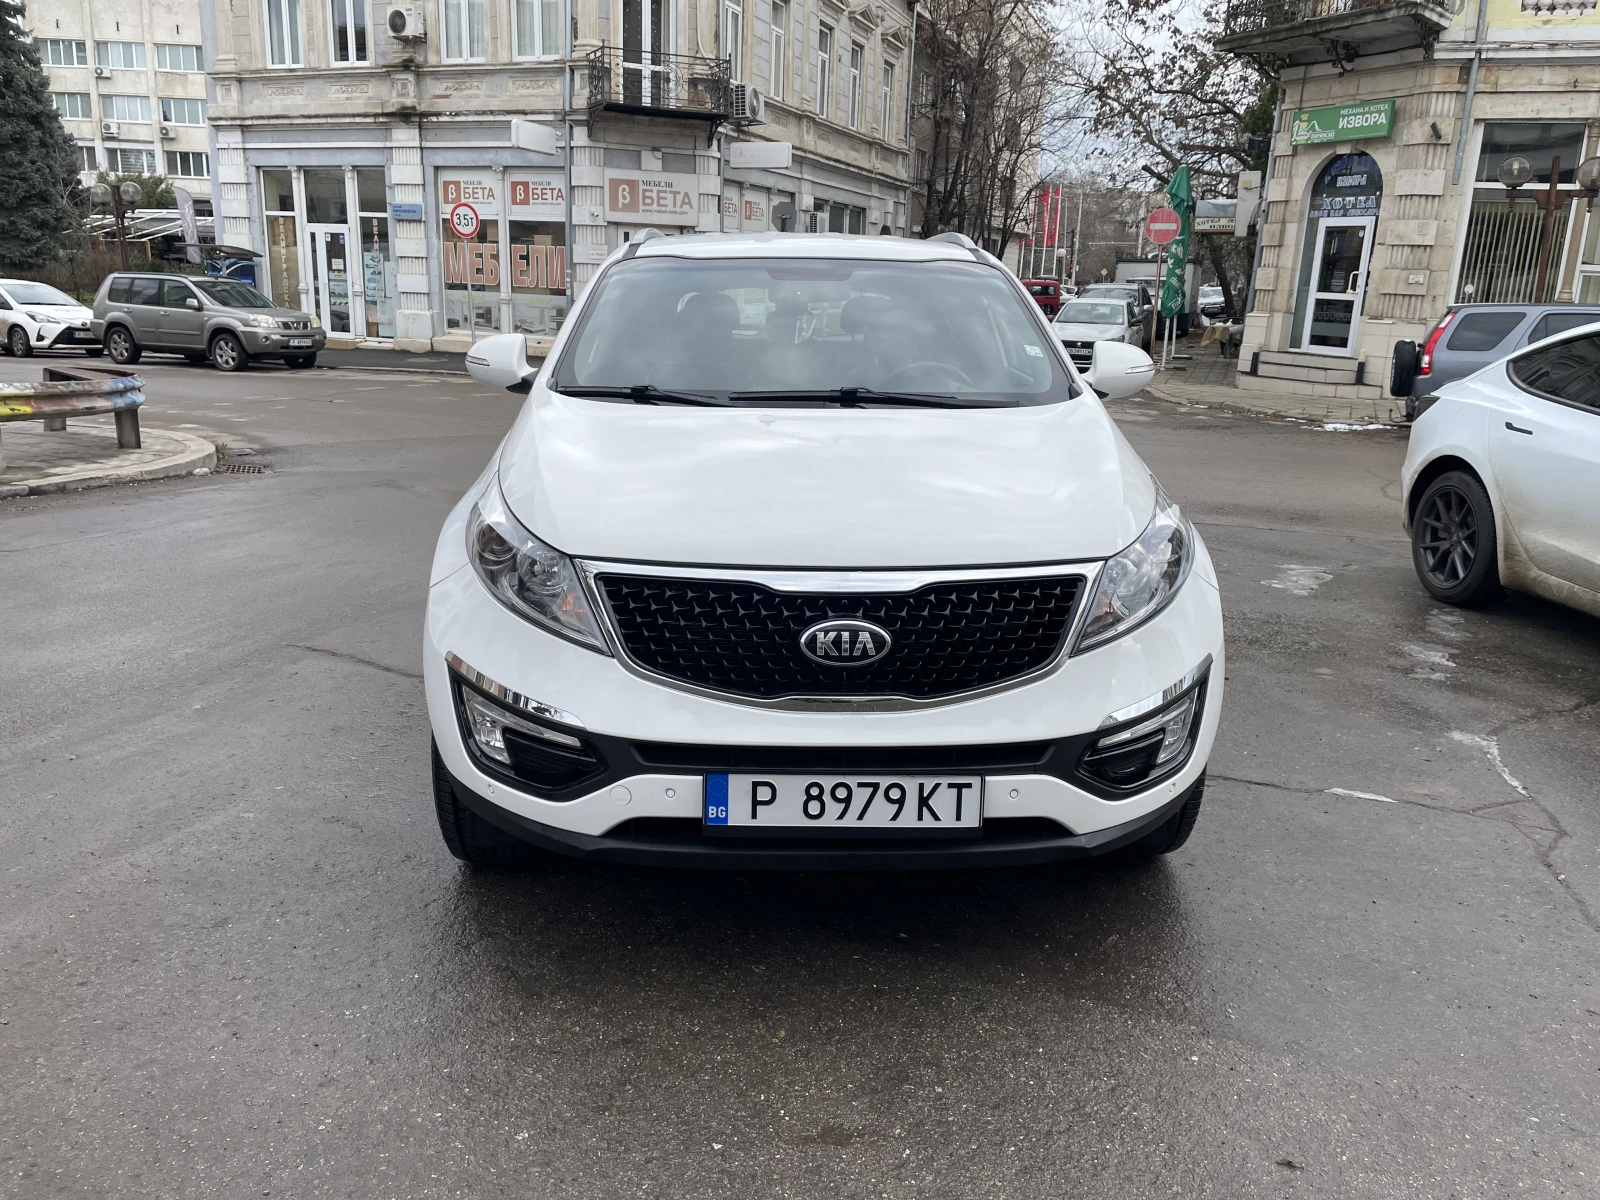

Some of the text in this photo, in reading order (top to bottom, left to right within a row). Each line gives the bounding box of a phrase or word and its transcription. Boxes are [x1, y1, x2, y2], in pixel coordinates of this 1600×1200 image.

[1340, 105, 1363, 115] МЕХАНА
[1370, 103, 1388, 111] ХОТЕЛ
[1338, 112, 1387, 129] ИЗВОРА
[641, 179, 673, 189] МЕБЕЛИ
[463, 186, 496, 200] БЕТА
[531, 187, 565, 201] БЕТА
[641, 188, 694, 209] БЕТА
[1321, 196, 1376, 209] ХОТЕЛ
[816, 631, 876, 656] KIA
[750, 780, 777, 820] P
[708, 806, 727, 818] BG
